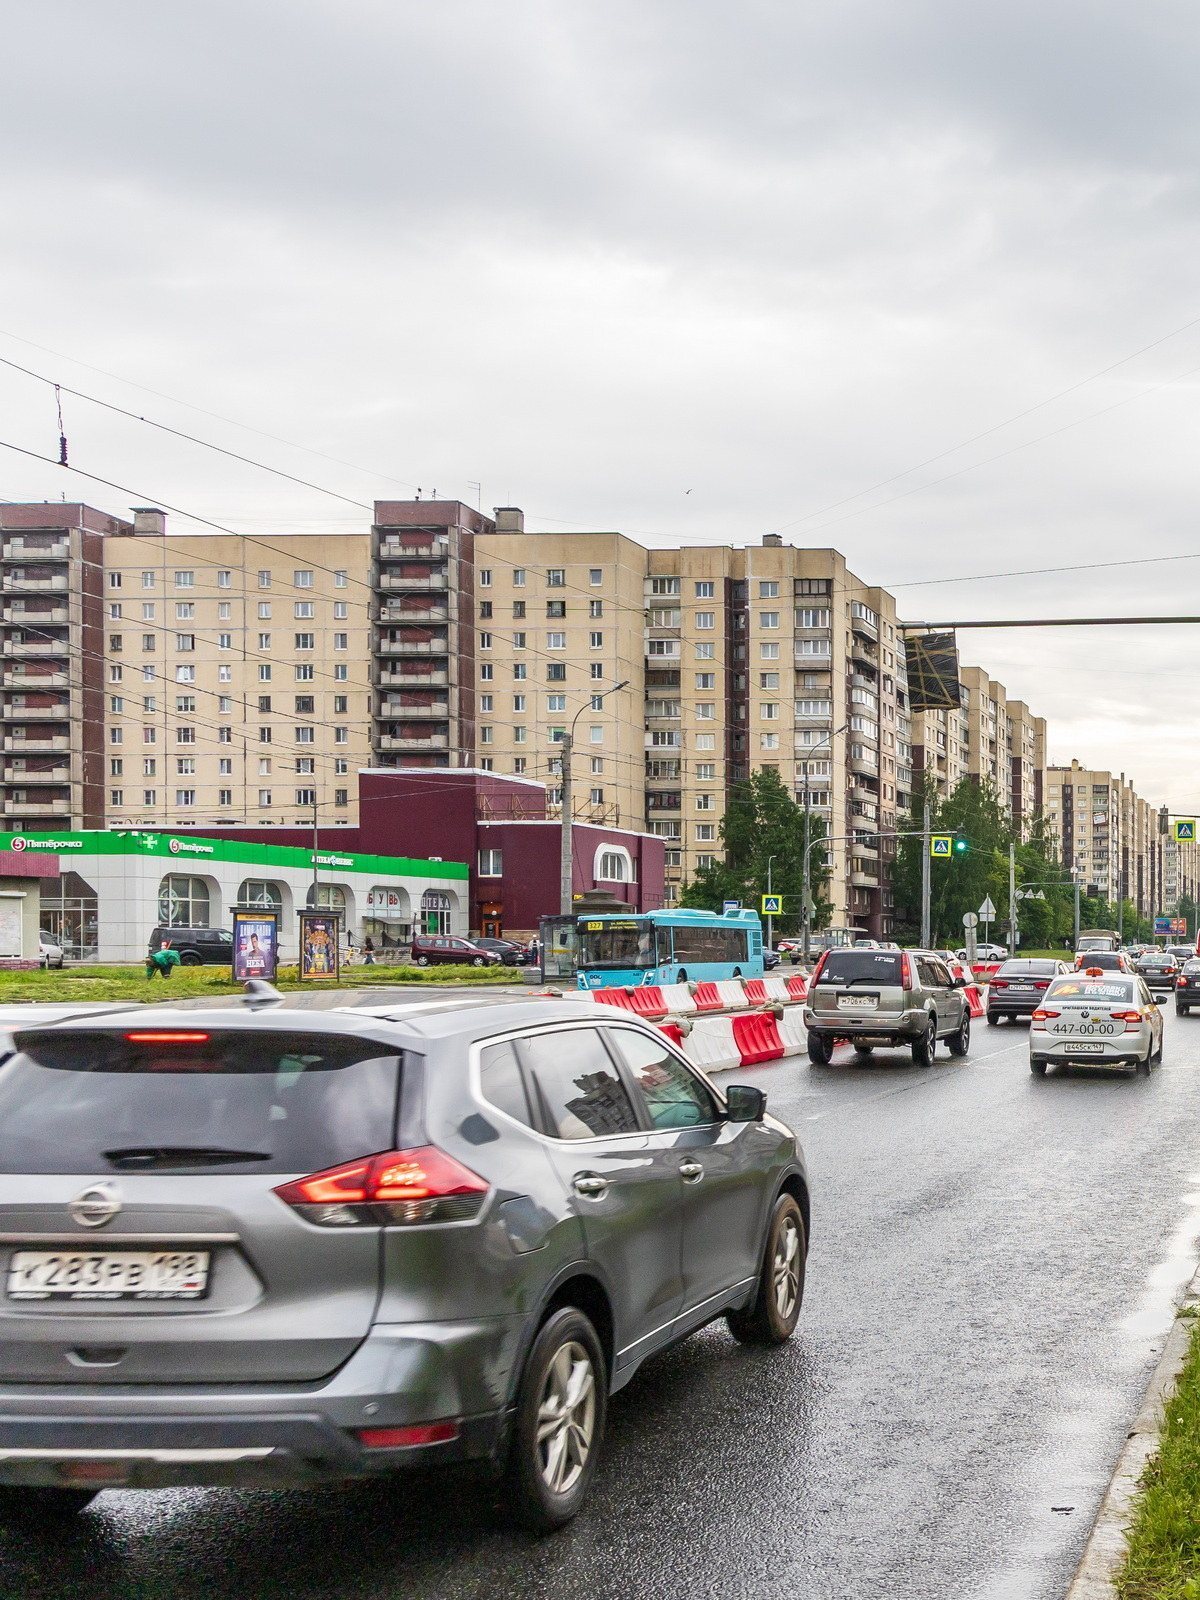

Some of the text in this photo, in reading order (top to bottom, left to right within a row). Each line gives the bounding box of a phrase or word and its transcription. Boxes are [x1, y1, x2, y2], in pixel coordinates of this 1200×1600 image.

[27, 839, 83, 849] Пятёрочка
[367, 892, 398, 905] БУВЬ
[421, 897, 450, 909] ПТЕКА
[1053, 1023, 1114, 1035] 447-00-00
